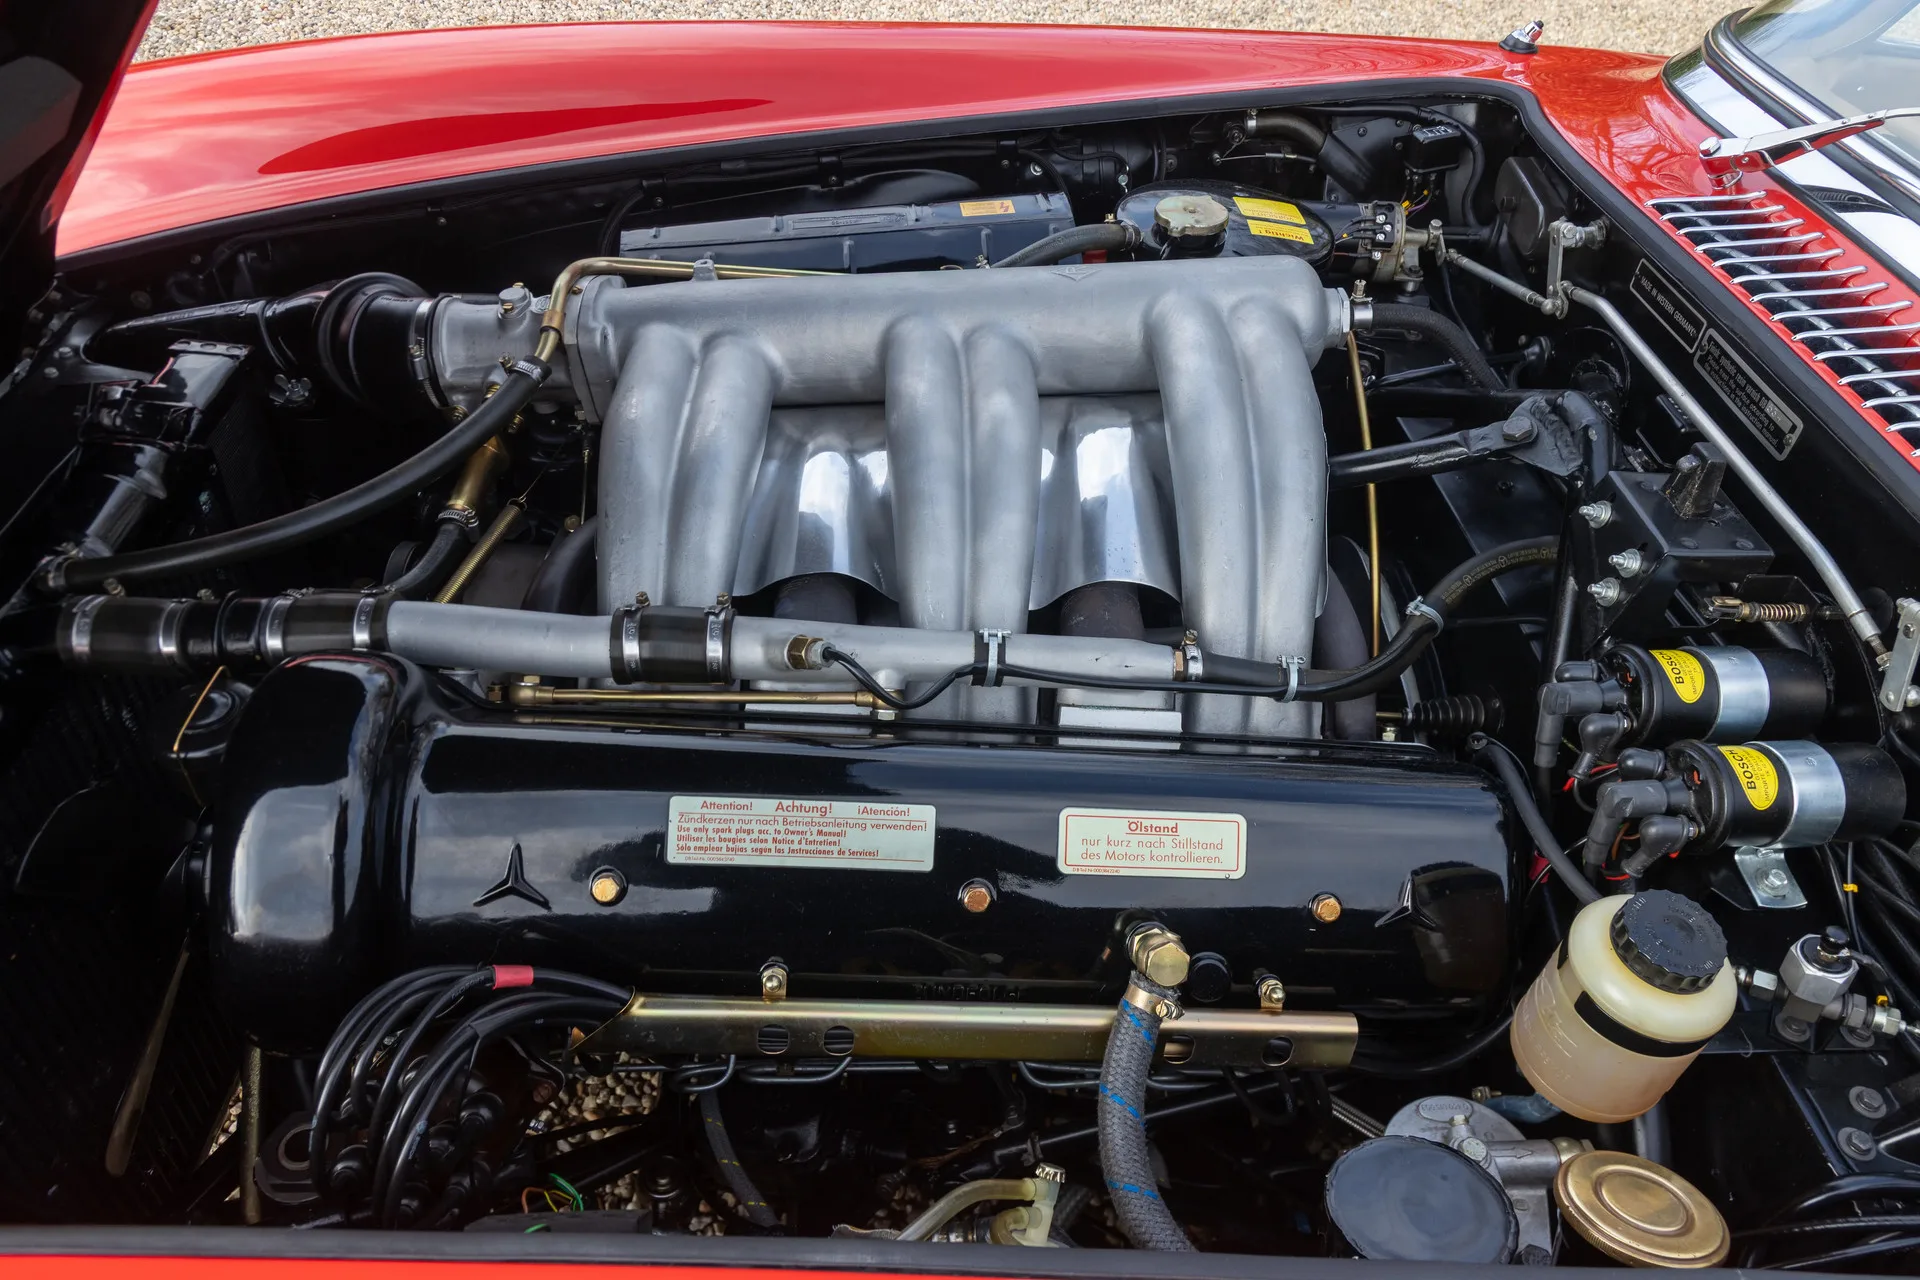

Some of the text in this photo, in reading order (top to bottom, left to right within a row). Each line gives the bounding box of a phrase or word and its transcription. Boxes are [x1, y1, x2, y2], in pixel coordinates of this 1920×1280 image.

[1265, 229, 1304, 241] Wichtig
[1640, 276, 1652, 292] MADE
[1651, 287, 1658, 298] IN
[1656, 292, 1675, 315] WESTERN
[1656, 651, 1685, 684] BOSCH
[1725, 749, 1757, 790] BOSCH
[701, 800, 753, 811] Attention!
[775, 800, 832, 817] Achtung!
[678, 813, 735, 824] Zündkerzen
[756, 816, 779, 826] nach
[782, 816, 867, 832] Betriebsanleitung
[870, 820, 927, 832] verwenden!
[1127, 820, 1179, 834] Ölstand
[676, 834, 704, 842] Utiliser
[706, 835, 716, 843] les
[718, 835, 746, 844] bougies
[772, 837, 794, 845] Notice
[694, 825, 708, 834] only
[712, 826, 732, 834] spark
[735, 826, 754, 836] plugs
[784, 828, 814, 836] Owner's
[816, 829, 846, 838] Manual!
[694, 844, 723, 854] emplear
[751, 846, 772, 854] según
[774, 846, 784, 854] las
[837, 848, 846, 856] de
[848, 848, 879, 857] Services!
[1081, 835, 1224, 851] nur kurz nach Stillstand
[1080, 848, 1223, 864] des Motors kontrollieren.
